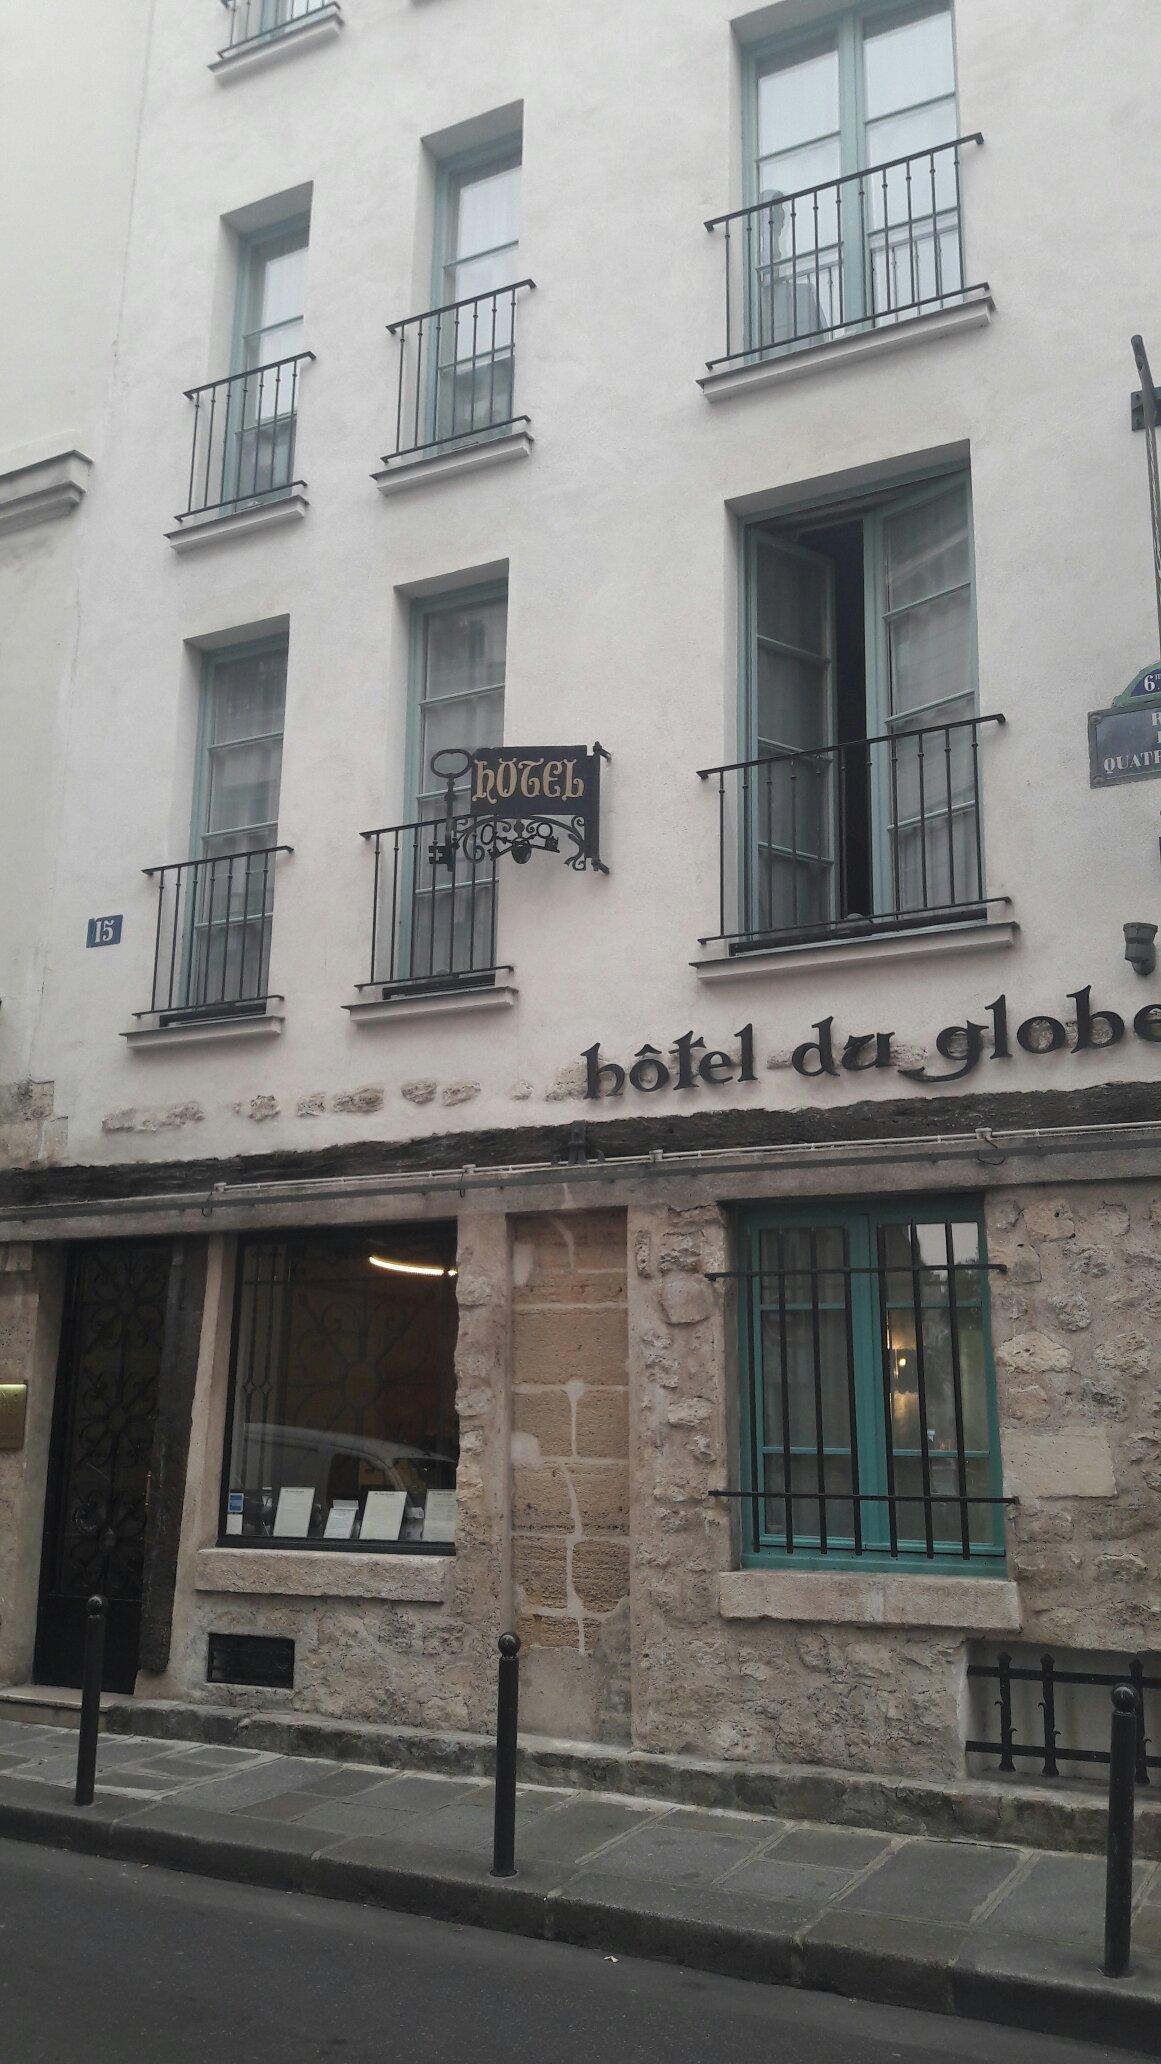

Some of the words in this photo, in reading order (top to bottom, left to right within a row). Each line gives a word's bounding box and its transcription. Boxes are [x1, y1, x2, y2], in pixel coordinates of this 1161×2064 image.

[94, 919, 115, 943] 15
[580, 1022, 758, 1100] hôtel
[791, 1015, 897, 1078] du
[898, 984, 1161, 1083] globe
